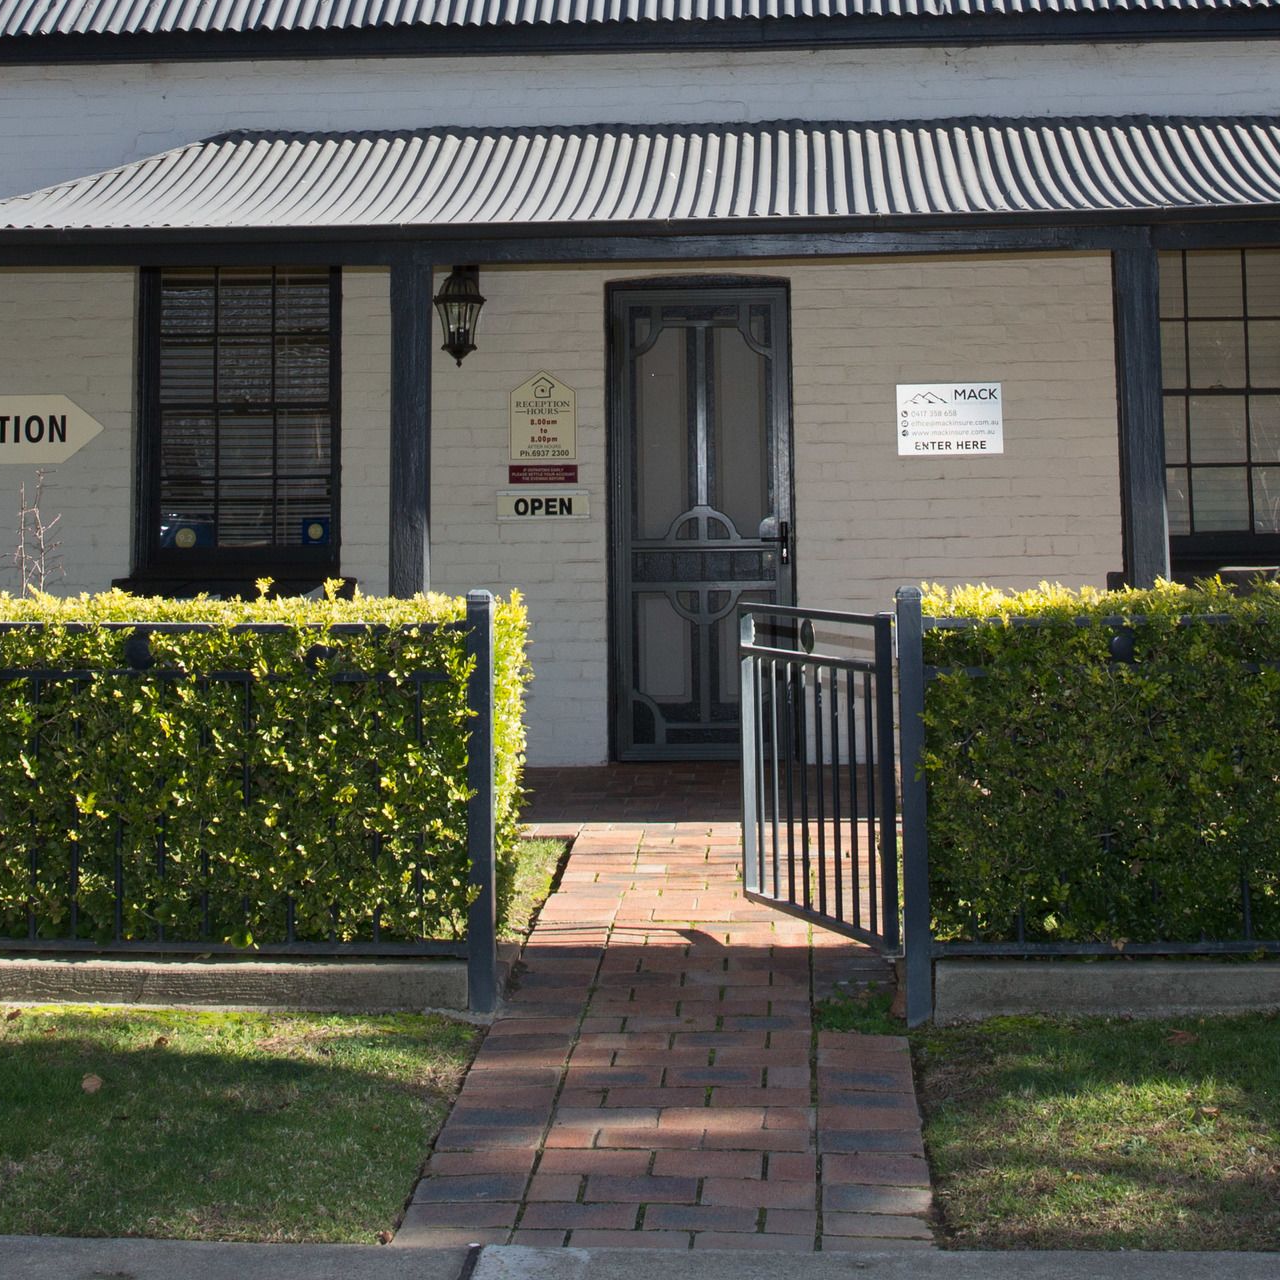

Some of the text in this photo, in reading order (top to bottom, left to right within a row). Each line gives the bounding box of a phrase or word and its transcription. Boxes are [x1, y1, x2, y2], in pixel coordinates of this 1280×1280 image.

[954, 388, 998, 401] MACK
[515, 400, 570, 408] RECEPTION
[914, 440, 987, 451] ENTER HERE
[514, 497, 573, 516] OPEN
